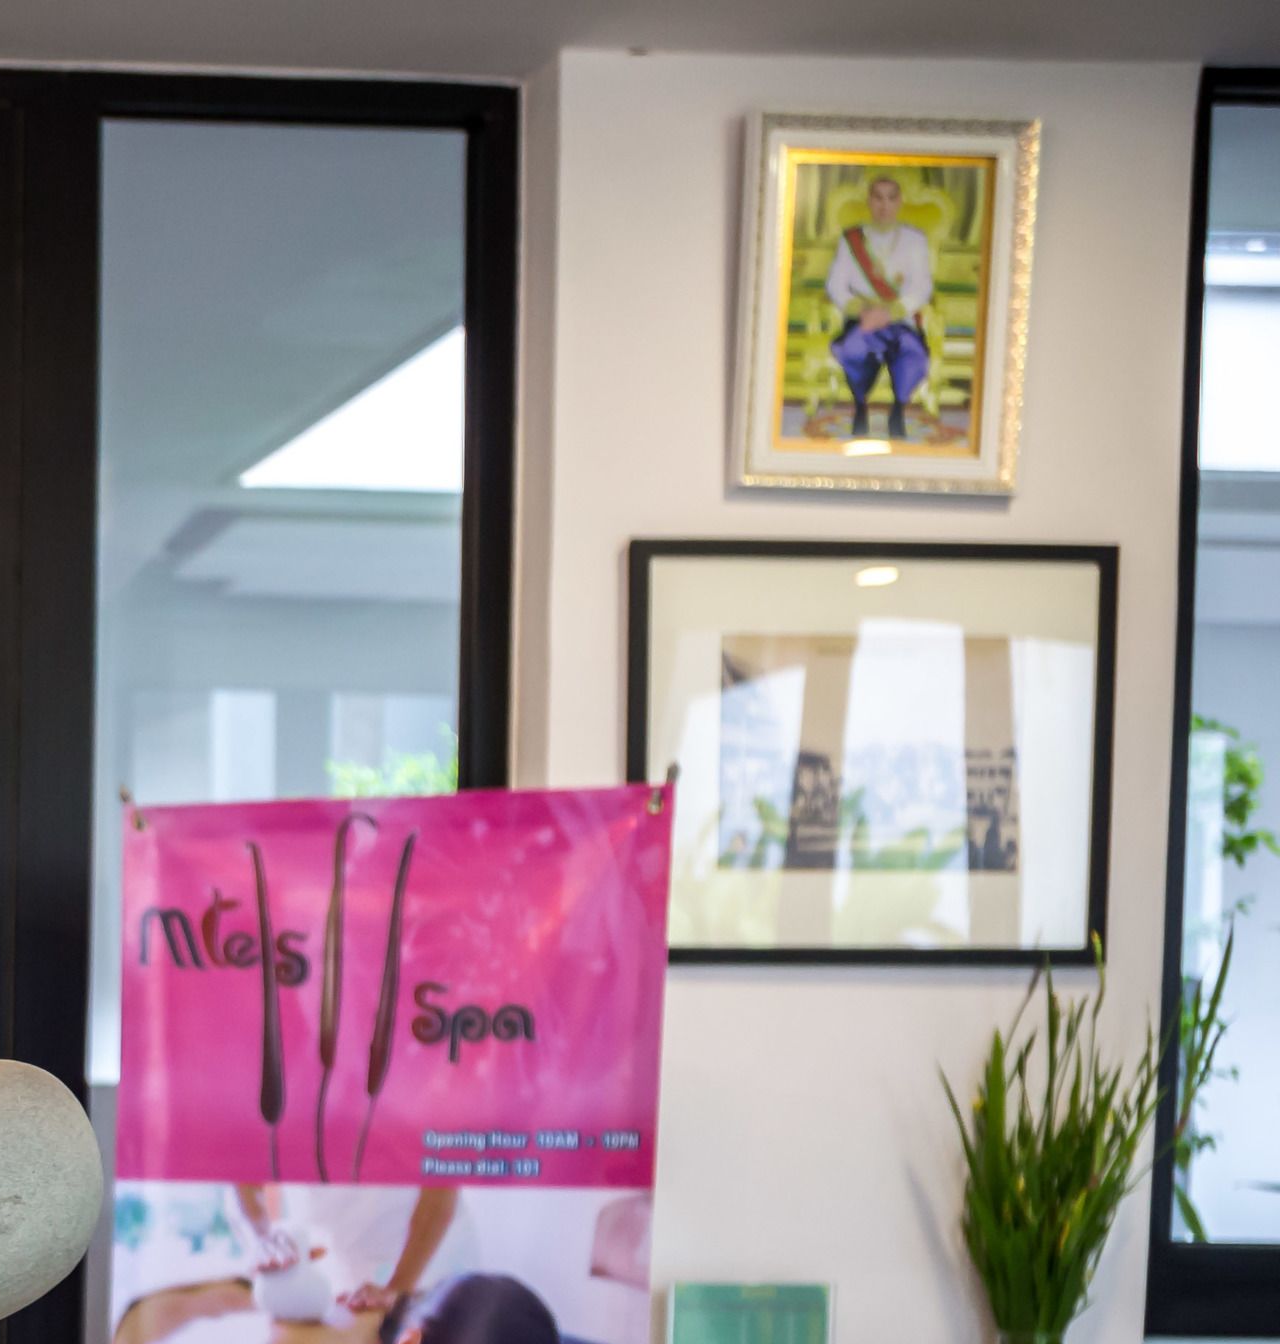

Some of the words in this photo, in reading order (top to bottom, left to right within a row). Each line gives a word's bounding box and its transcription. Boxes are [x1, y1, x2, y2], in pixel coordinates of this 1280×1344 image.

[412, 981, 536, 1064] Spa
[424, 1130, 487, 1151] Opening
[489, 1130, 528, 1149] Hour
[536, 1130, 579, 1149] 10AM
[602, 1130, 640, 1150] 10PM
[423, 1157, 472, 1175] Please
[514, 1158, 540, 1176] 101
